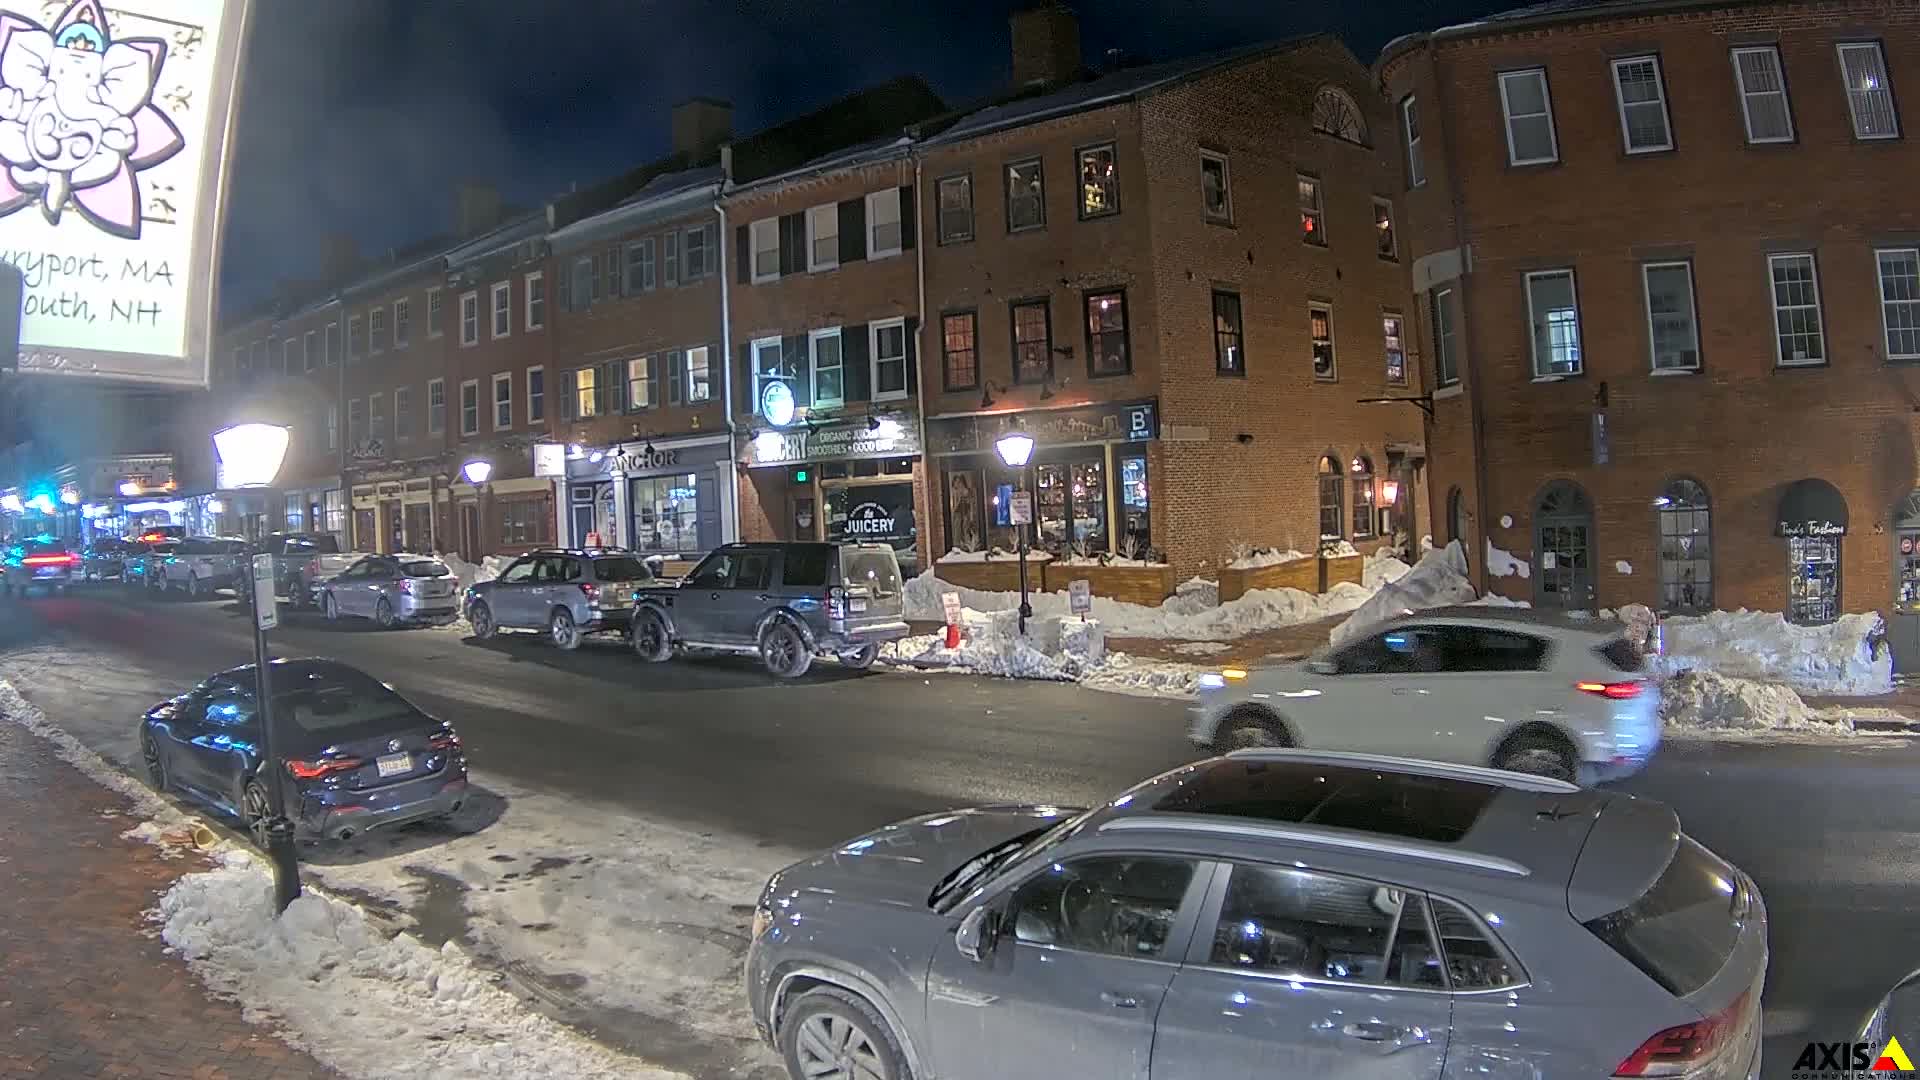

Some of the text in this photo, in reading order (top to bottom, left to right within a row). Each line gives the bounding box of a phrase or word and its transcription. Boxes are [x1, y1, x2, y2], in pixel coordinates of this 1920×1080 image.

[0, 250, 173, 287] ryport, MA
[110, 298, 162, 327] NH
[611, 449, 678, 471] ANCHOR
[757, 431, 808, 462] CERY
[843, 518, 895, 534] JUICERY
